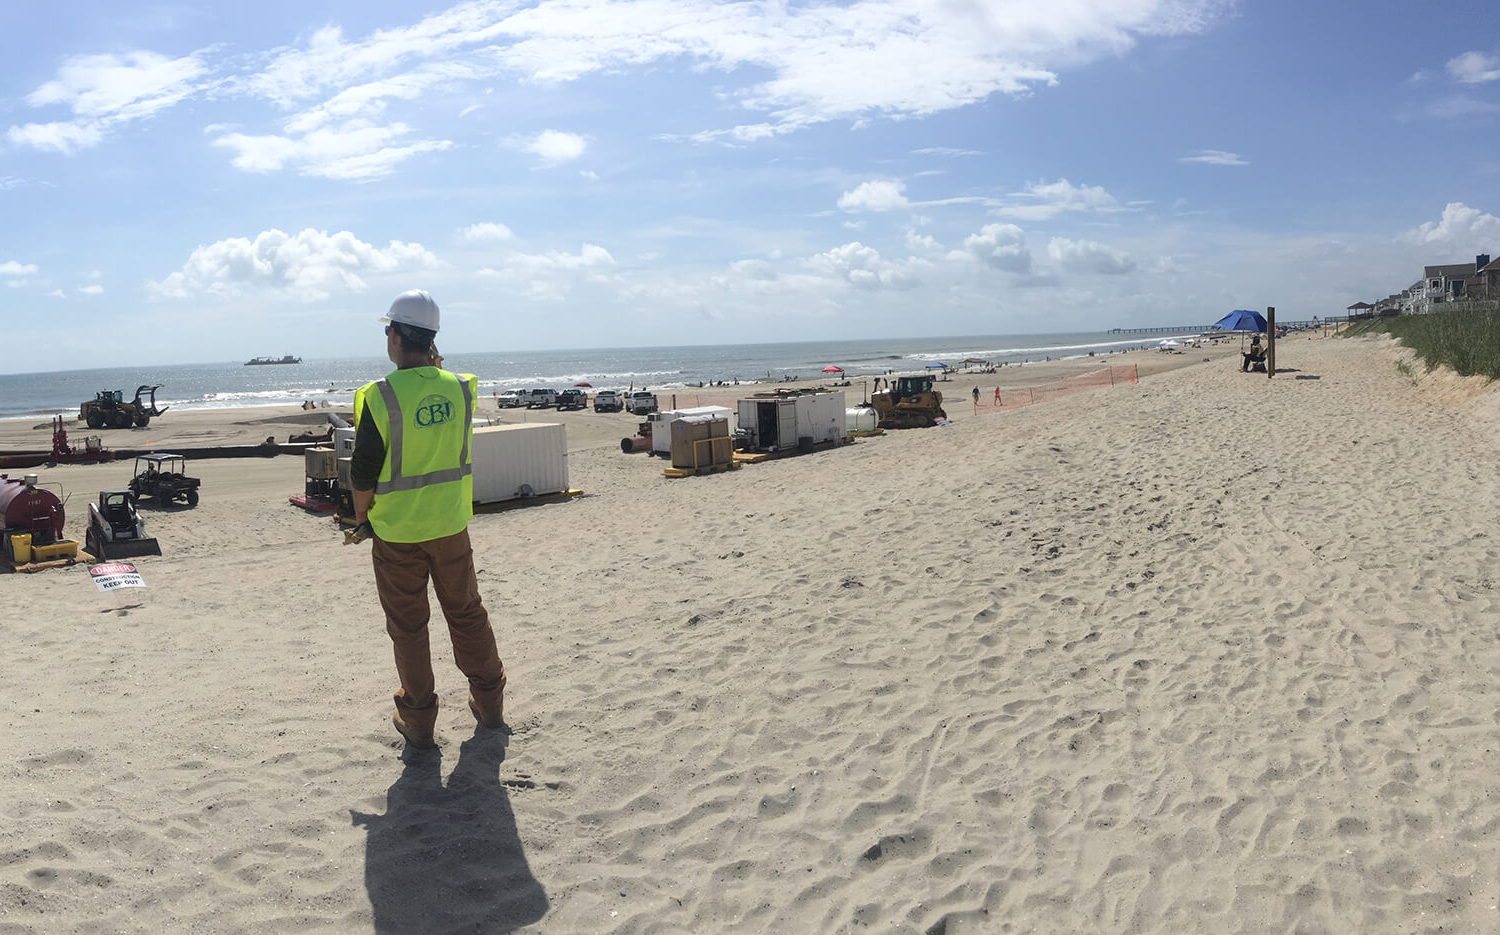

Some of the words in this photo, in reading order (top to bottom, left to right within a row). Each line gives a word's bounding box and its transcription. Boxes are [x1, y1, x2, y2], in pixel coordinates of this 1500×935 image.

[415, 402, 451, 427] CBI
[96, 565, 129, 575] DANGER
[96, 575, 140, 583] CONSTRUCTION
